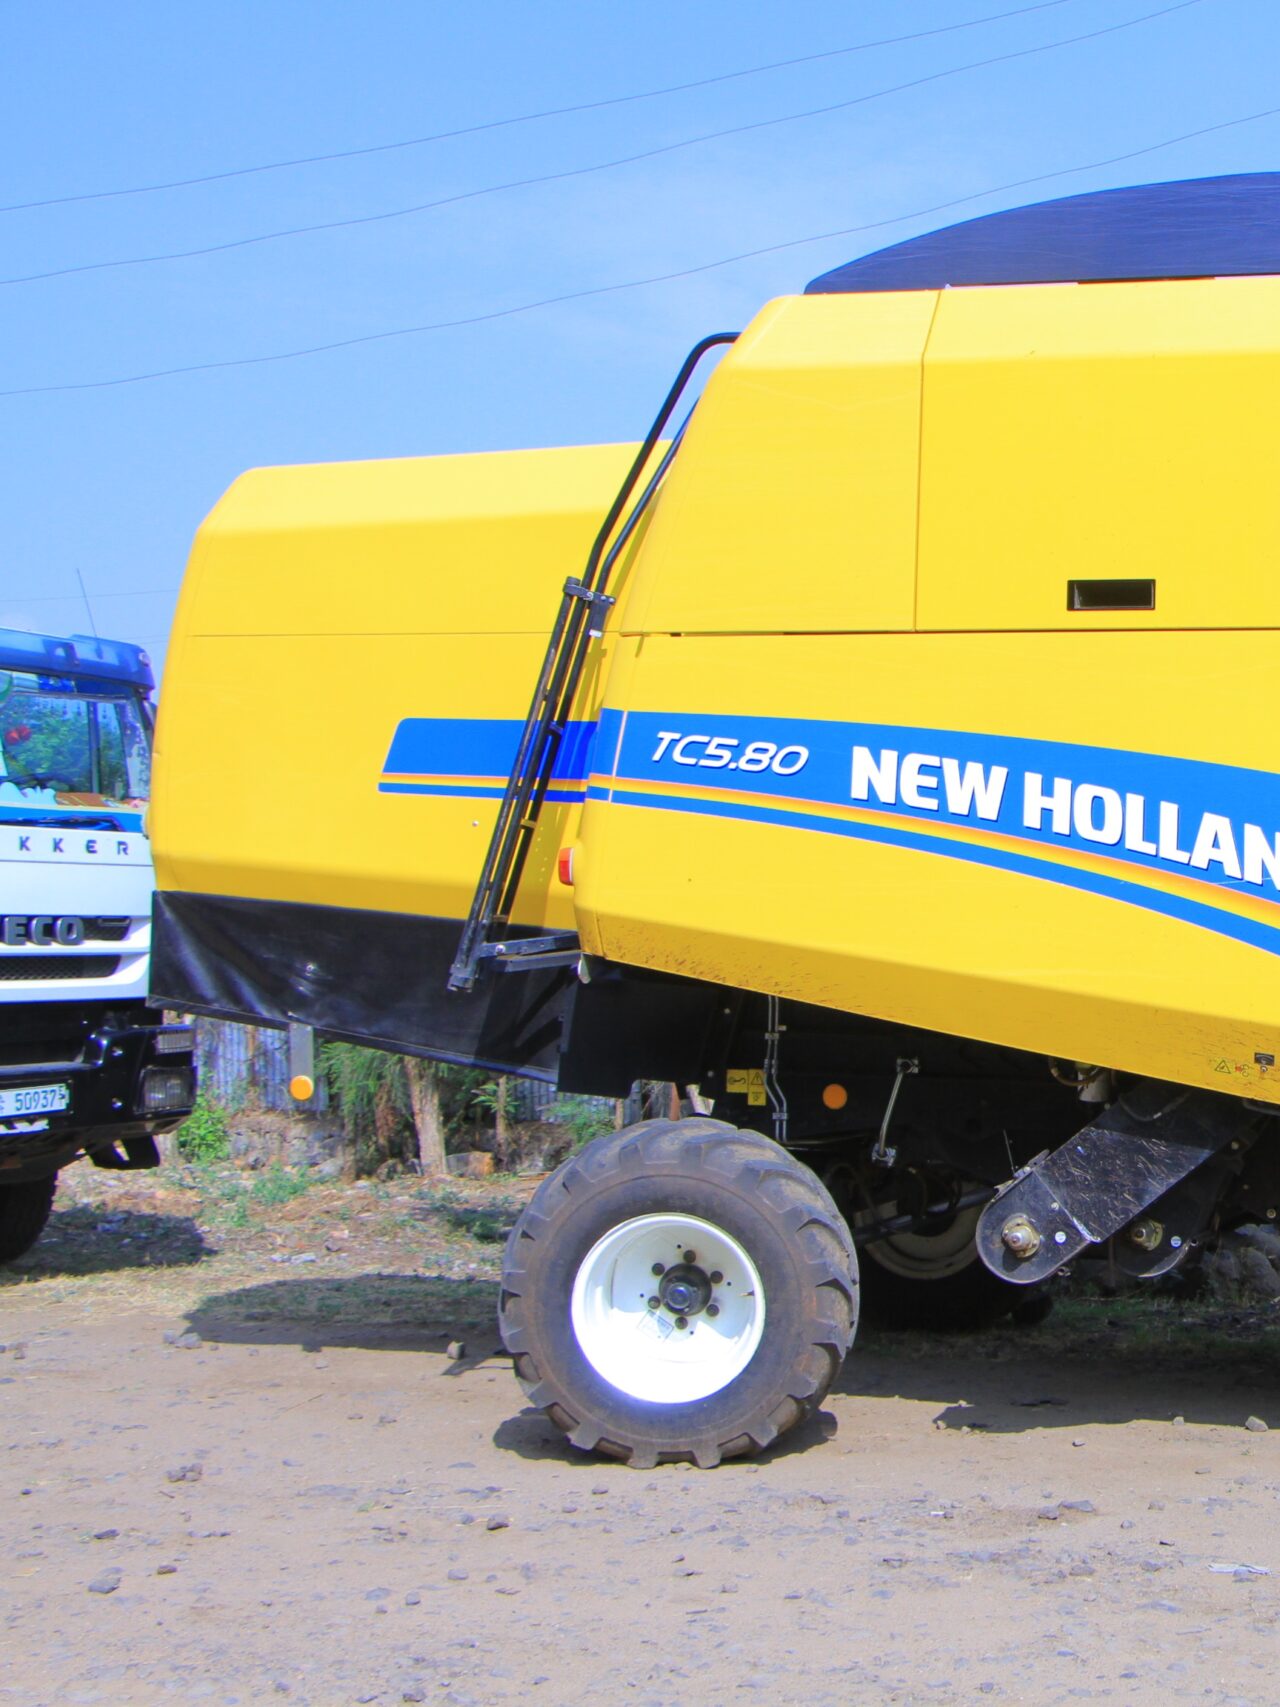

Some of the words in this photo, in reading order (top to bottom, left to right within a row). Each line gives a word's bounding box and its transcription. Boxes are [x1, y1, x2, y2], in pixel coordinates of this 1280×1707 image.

[652, 731, 809, 776] TC5.80
[850, 745, 1008, 822] NEW
[19, 836, 129, 855] KKER
[4, 915, 84, 946] ECO
